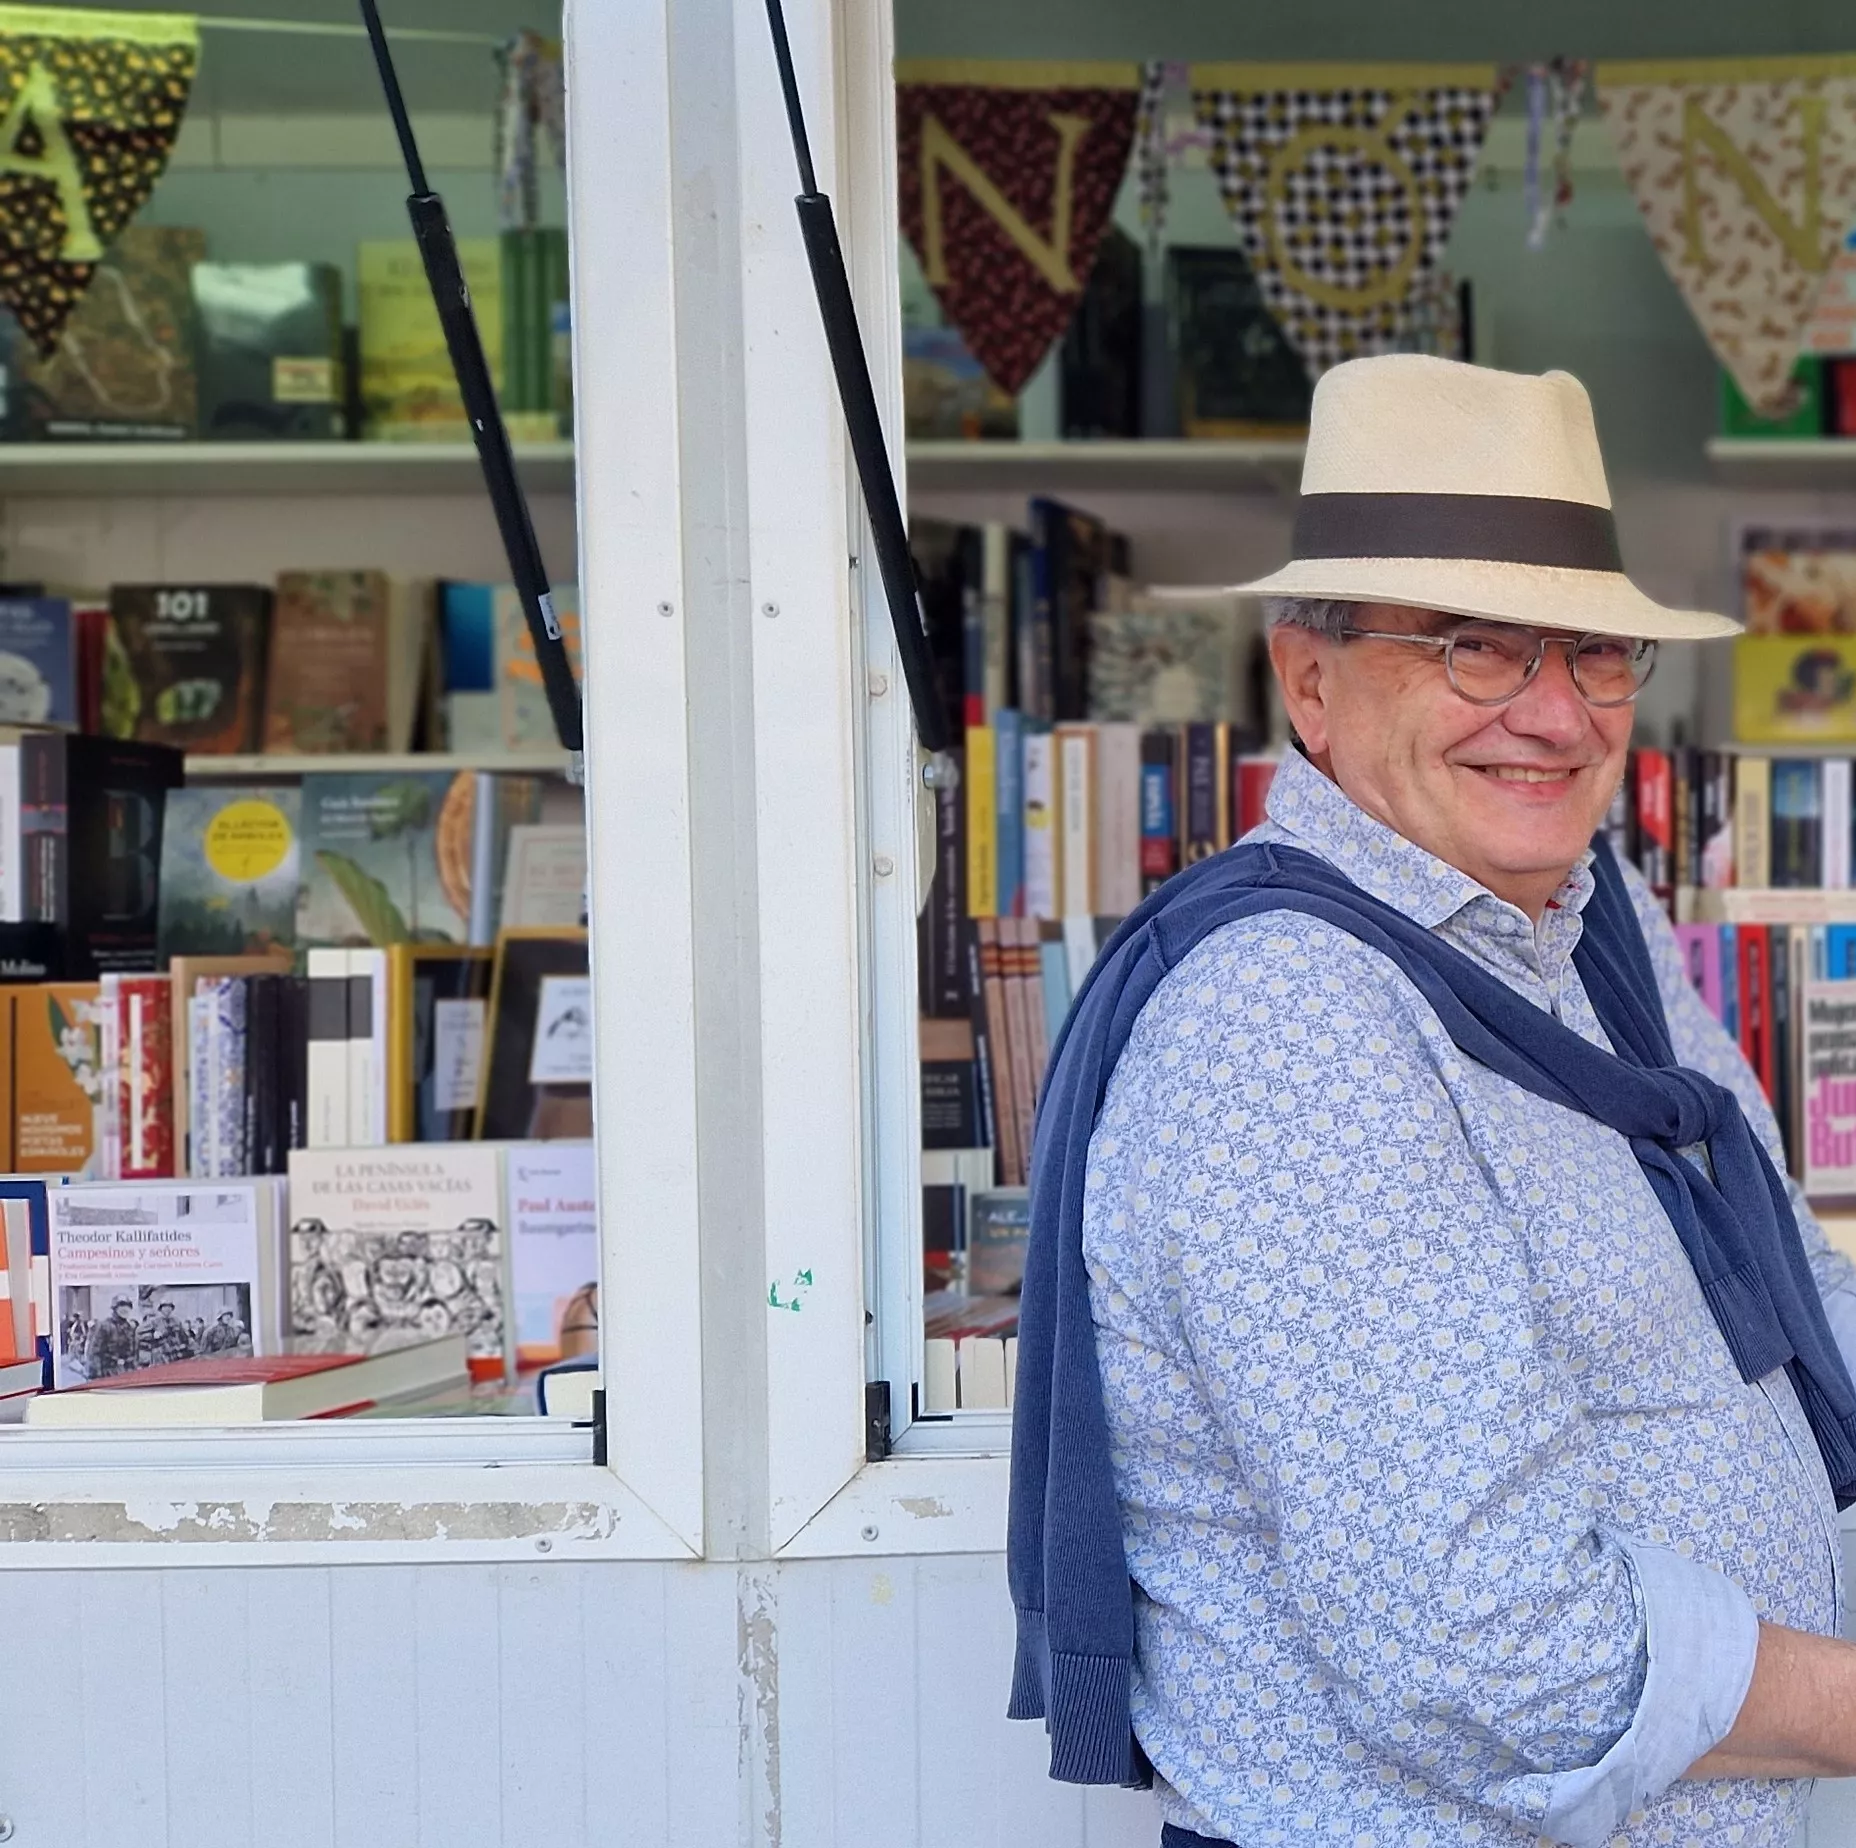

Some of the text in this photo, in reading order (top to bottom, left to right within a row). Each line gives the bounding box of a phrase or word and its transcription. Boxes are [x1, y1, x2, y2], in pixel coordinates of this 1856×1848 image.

[920, 110, 1093, 294] N
[1682, 96, 1826, 275] N
[155, 591, 208, 620] 101
[556, 1199, 595, 1213] Auste
[57, 1229, 192, 1242] Theodor Kallifatides
[57, 1245, 200, 1260] Campesinos y señores
